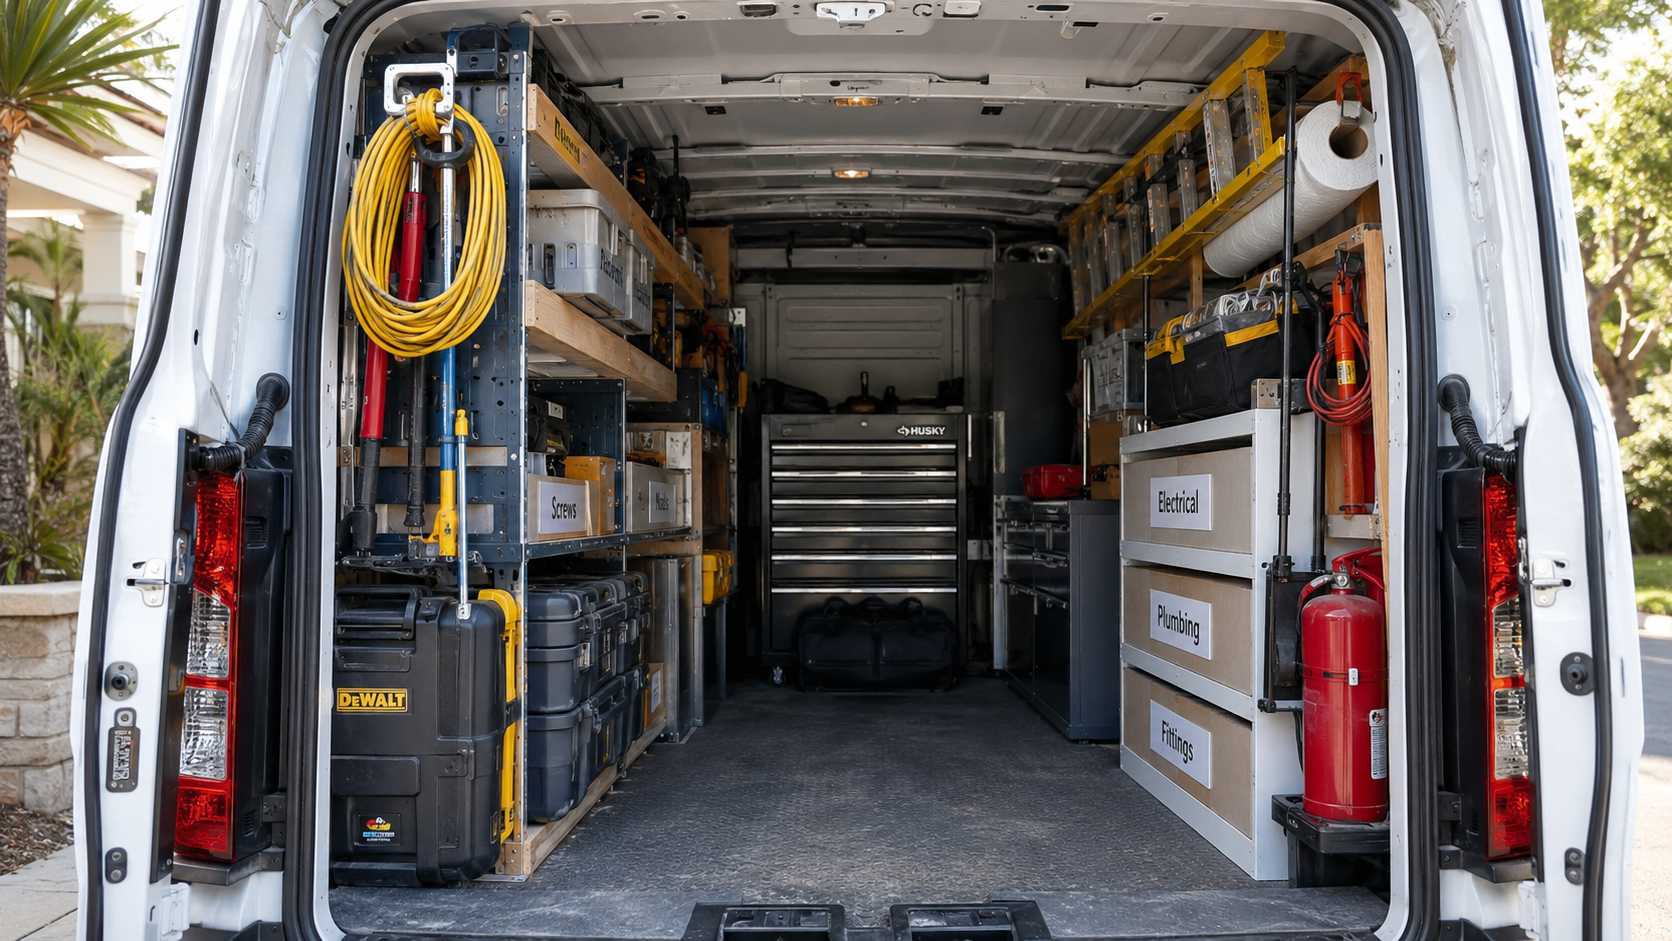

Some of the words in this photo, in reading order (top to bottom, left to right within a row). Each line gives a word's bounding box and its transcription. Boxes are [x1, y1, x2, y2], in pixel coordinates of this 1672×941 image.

[910, 426, 946, 435] HUSKY
[551, 496, 577, 520] Screws
[1158, 489, 1199, 514] Electrical
[1157, 604, 1200, 646] Plumbing
[339, 692, 406, 707] DEWALT
[1161, 719, 1194, 764] Fittings
